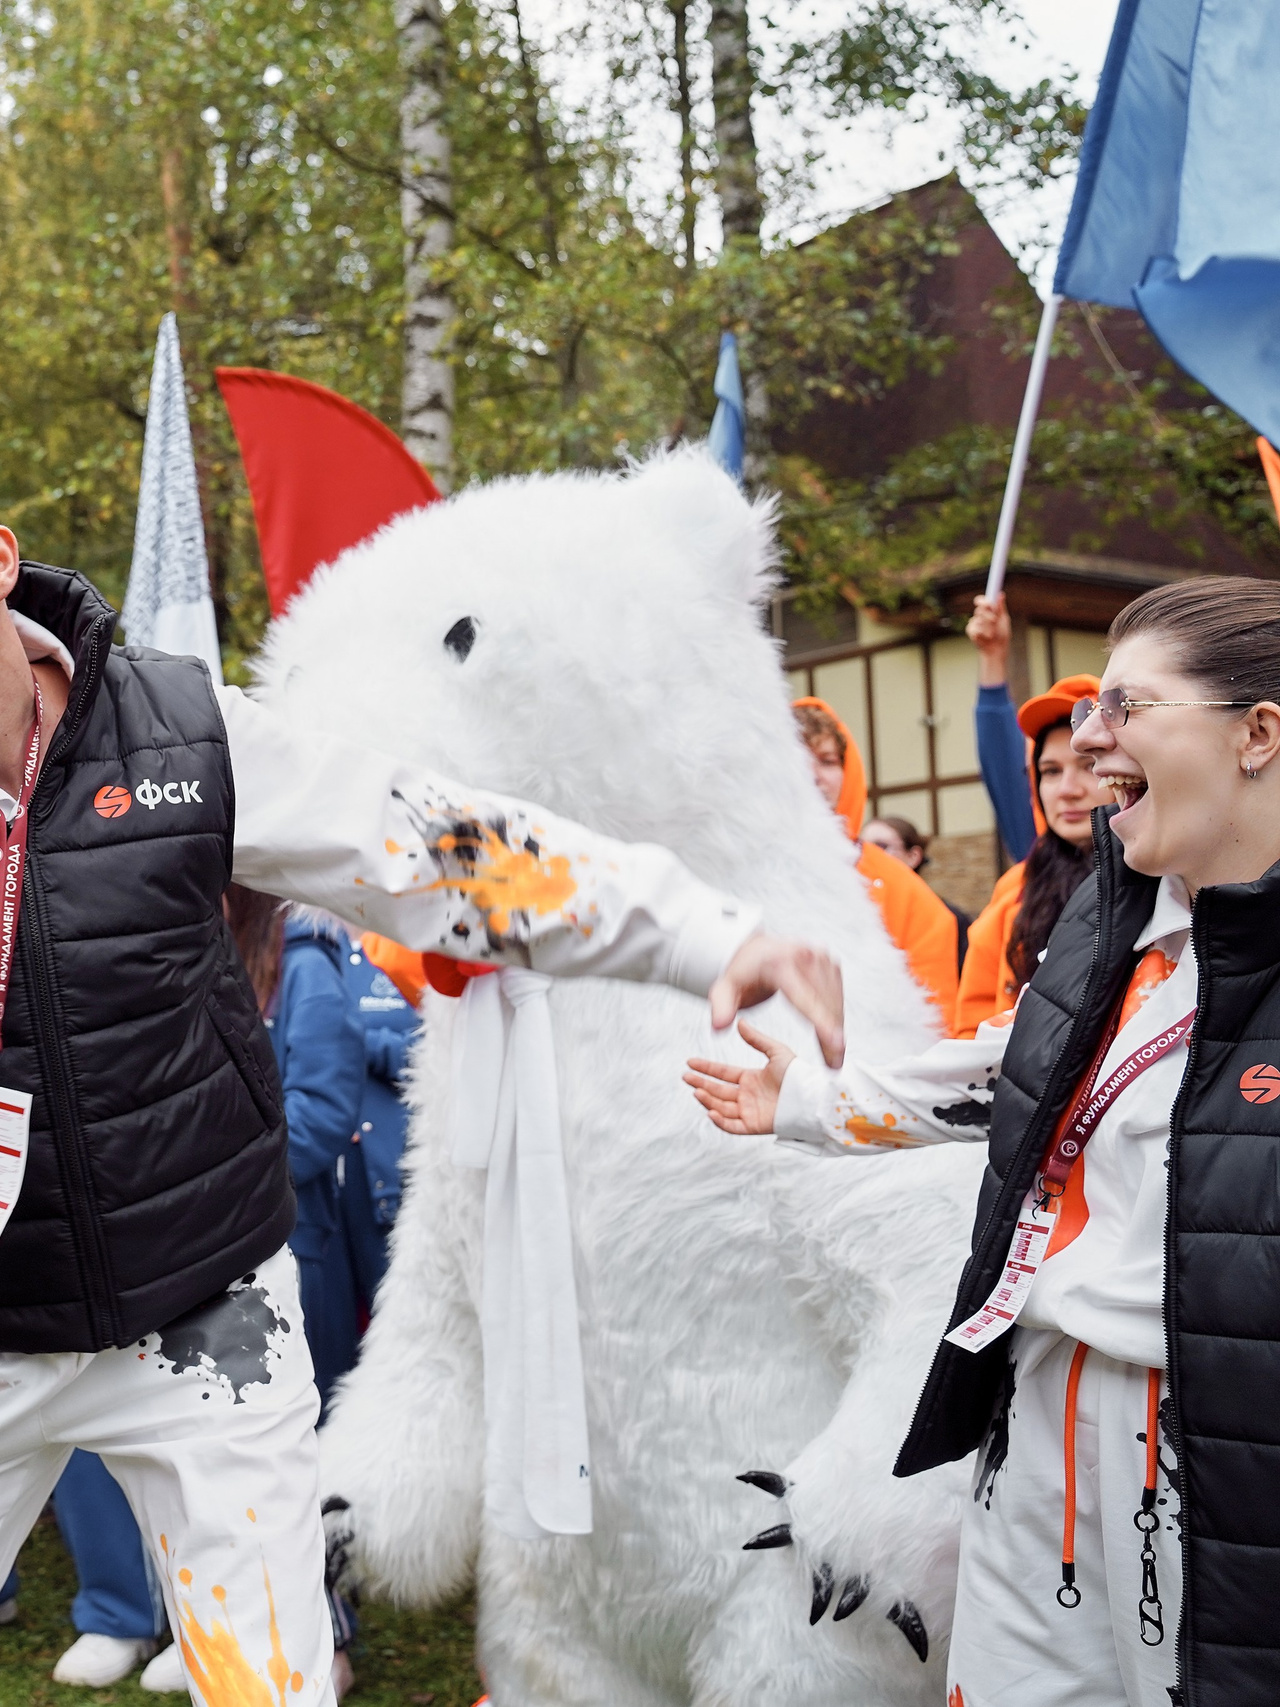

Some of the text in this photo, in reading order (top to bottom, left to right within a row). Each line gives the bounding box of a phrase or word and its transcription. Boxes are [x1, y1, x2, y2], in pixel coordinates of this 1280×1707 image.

[135, 779, 203, 810] ФСК
[4, 844, 20, 898] ГОРОДА
[0, 900, 15, 981] ФУНДАМЕНТ
[1075, 1026, 1185, 1135] Я ФУНДАМЕНТ ГОРОДА
